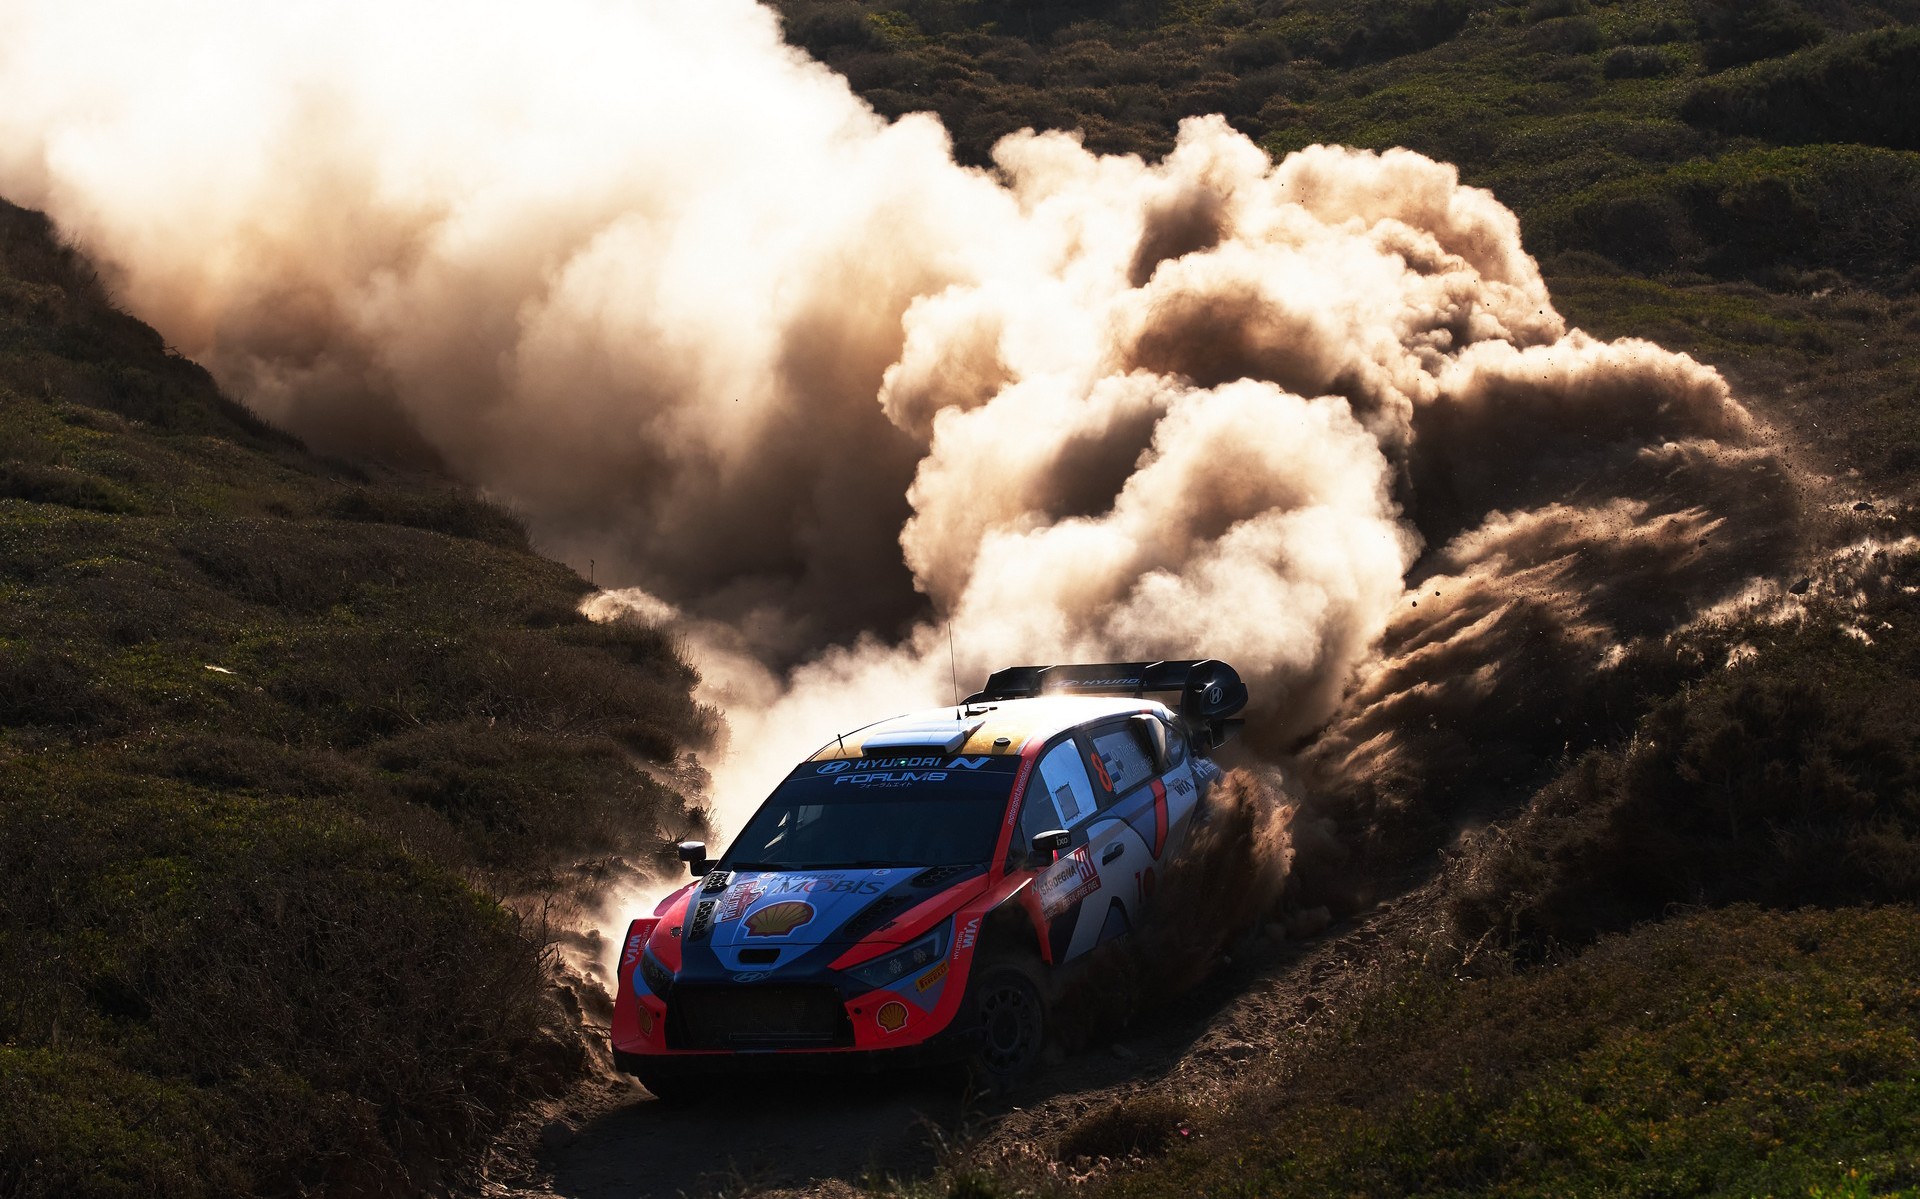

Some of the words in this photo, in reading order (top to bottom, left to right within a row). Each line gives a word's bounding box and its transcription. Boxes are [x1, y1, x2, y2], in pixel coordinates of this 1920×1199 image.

[855, 757, 941, 769] HYUNDAI
[1090, 752, 1113, 792] 8
[834, 772, 948, 785] FORUM8
[1008, 759, 1031, 826] motorsport.hyundai.com
[1174, 779, 1194, 796] WIA
[770, 873, 846, 882] HYUNDAI
[772, 880, 885, 895] MOBIS
[1040, 864, 1078, 896] SARDEGNA
[953, 930, 964, 961] HYUNDAI
[962, 918, 980, 949] WIA
[624, 934, 642, 966] WIA
[919, 962, 947, 990] PIRELLI
